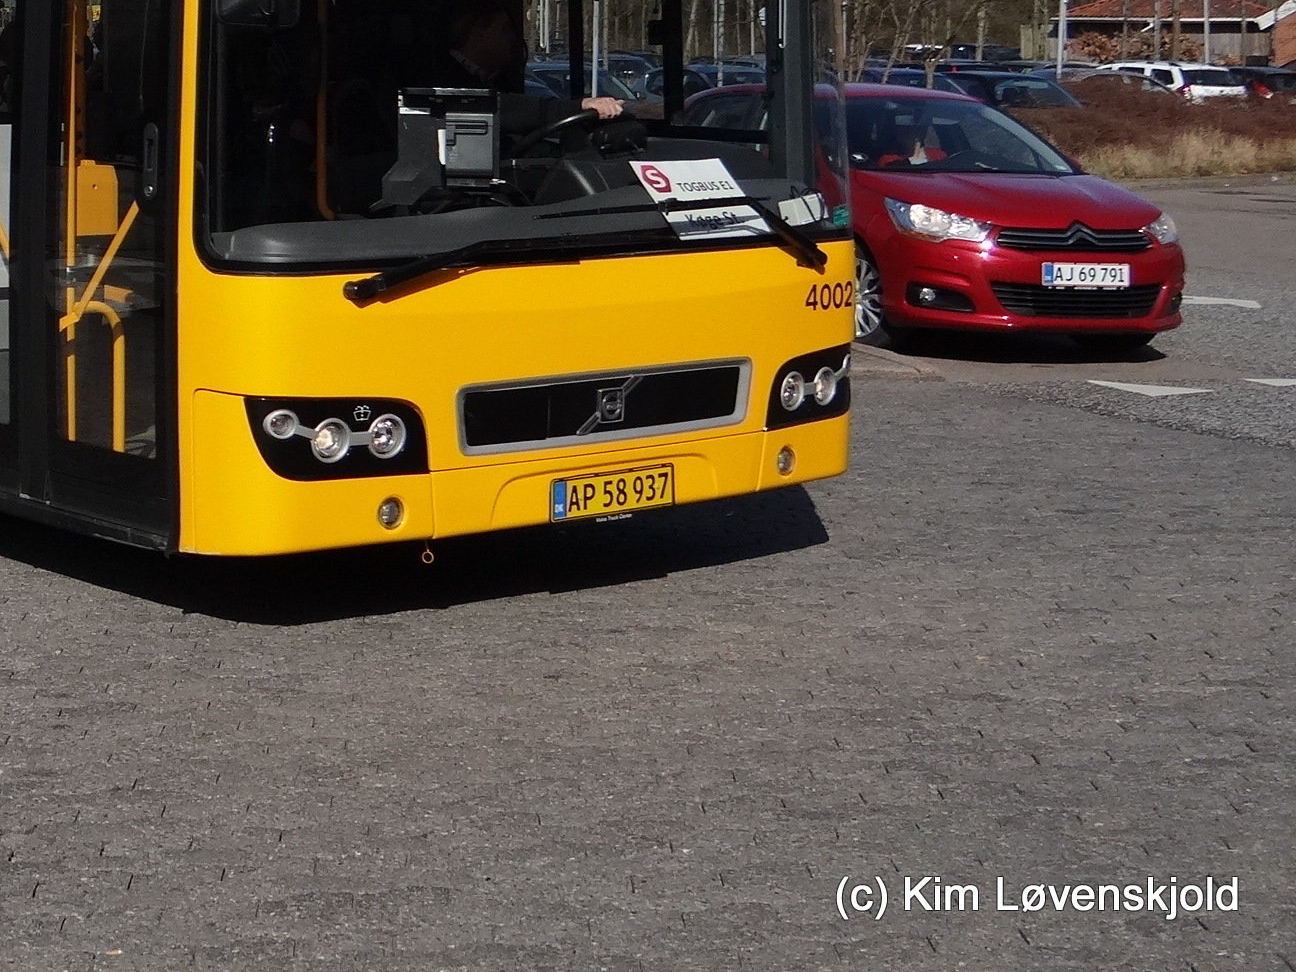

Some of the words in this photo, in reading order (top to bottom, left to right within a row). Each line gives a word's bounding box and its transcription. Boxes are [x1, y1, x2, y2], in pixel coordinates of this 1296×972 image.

[644, 169, 668, 189] S
[676, 181, 720, 193] TOGBUS
[720, 180, 735, 191] E1
[1054, 267, 1074, 282] AJ
[1078, 267, 1096, 283] 69
[1100, 268, 1125, 283] 791
[805, 280, 853, 311] 4002
[568, 482, 597, 513] AP
[602, 477, 628, 508] 58
[633, 472, 670, 504] 937
